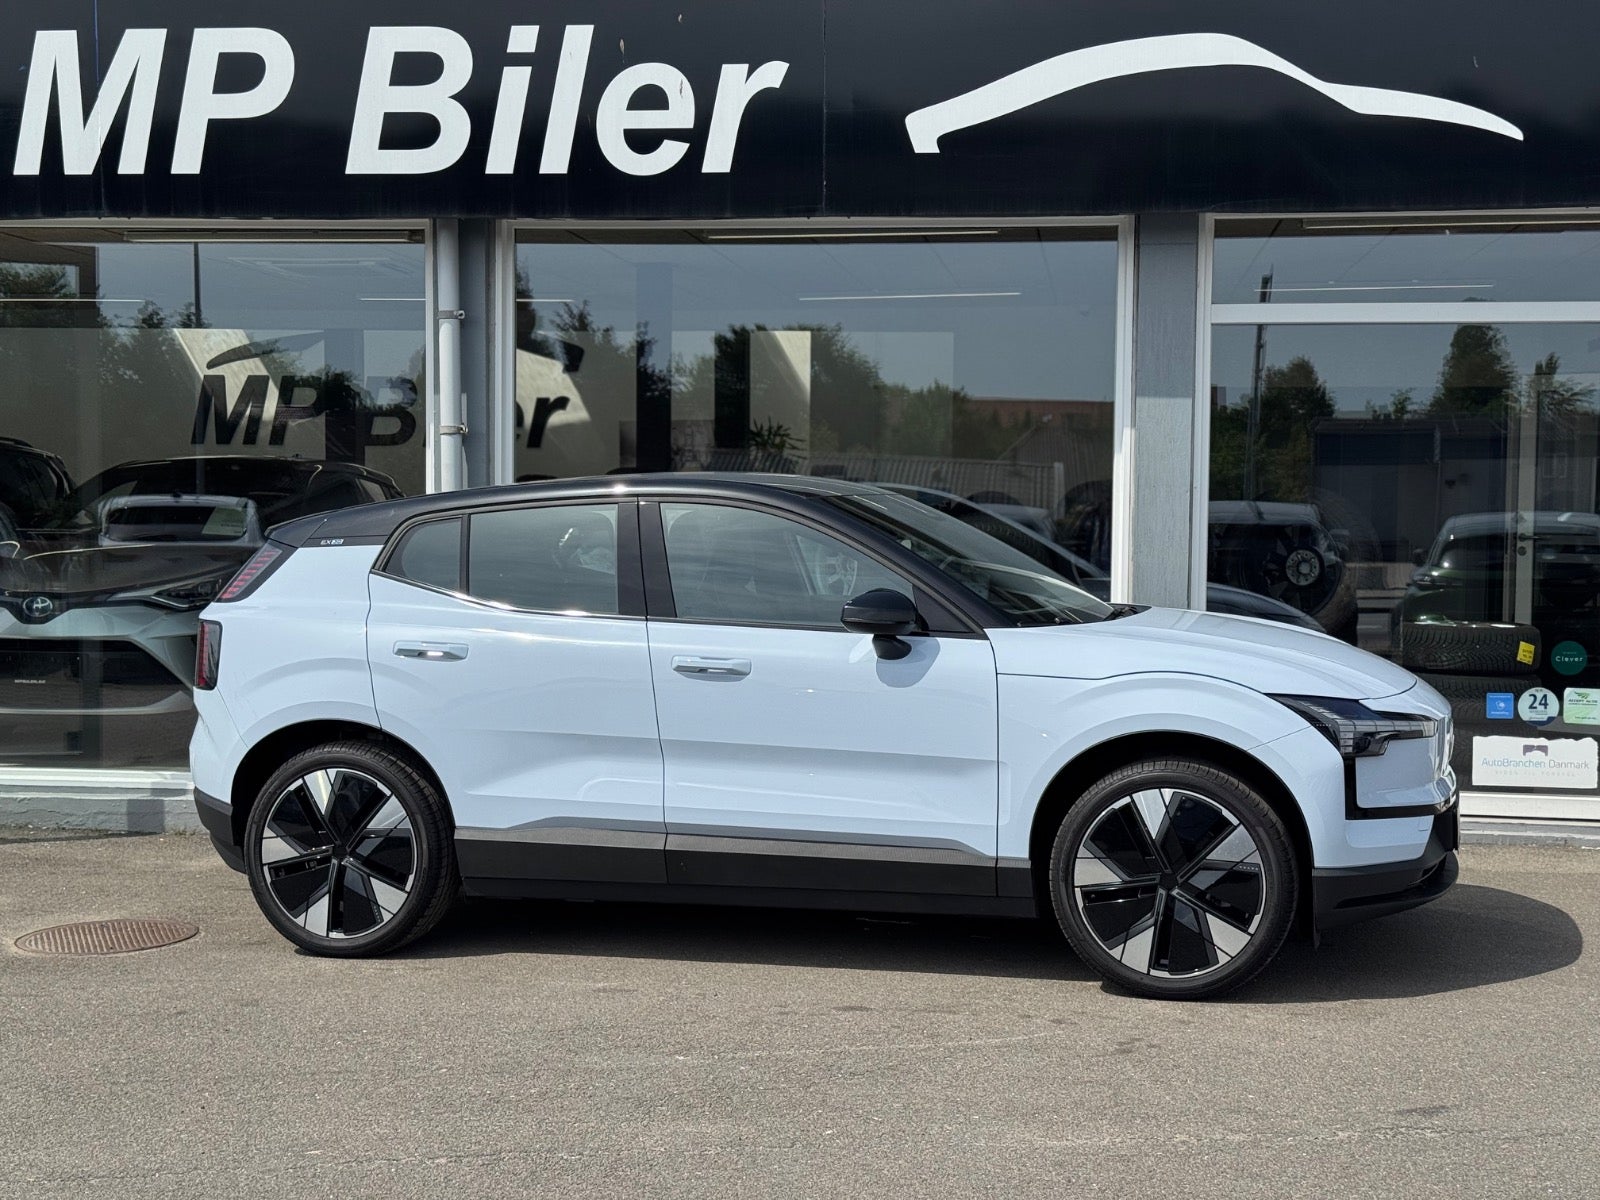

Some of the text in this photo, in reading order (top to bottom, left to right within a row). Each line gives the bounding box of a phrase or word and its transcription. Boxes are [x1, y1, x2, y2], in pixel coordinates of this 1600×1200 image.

[13, 25, 789, 175] MP Biler
[191, 374, 326, 446] MP
[1528, 693, 1549, 710] 24
[1481, 757, 1590, 769] AutoBranchen Danmark
